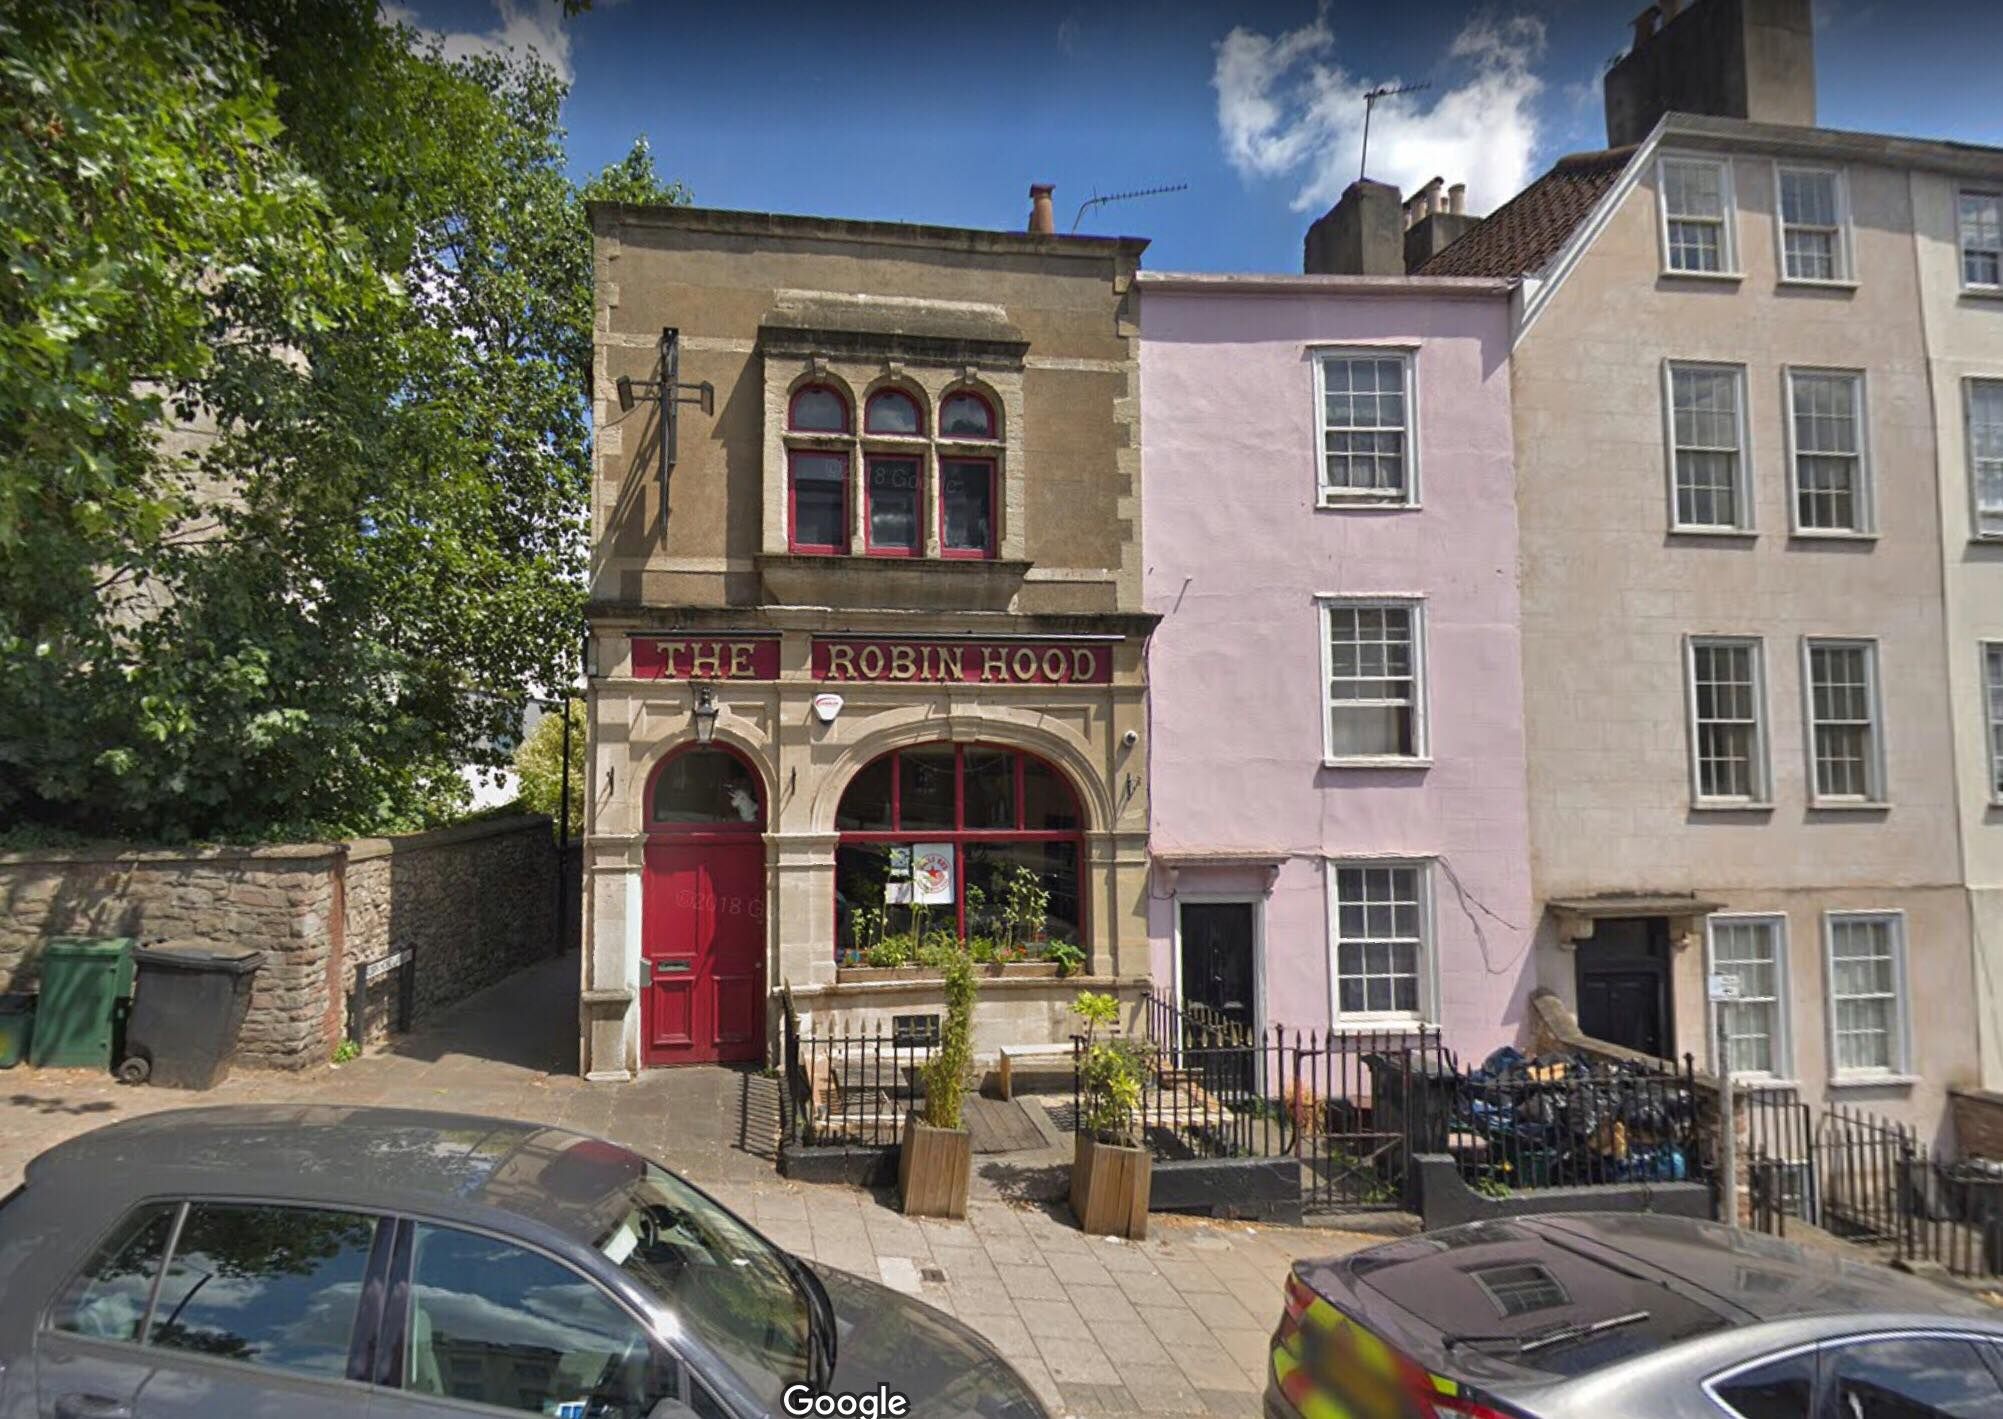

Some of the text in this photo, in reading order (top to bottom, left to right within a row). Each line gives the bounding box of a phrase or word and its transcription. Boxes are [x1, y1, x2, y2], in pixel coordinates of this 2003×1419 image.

[657, 642, 1097, 681] THE ROBIN HOOD
